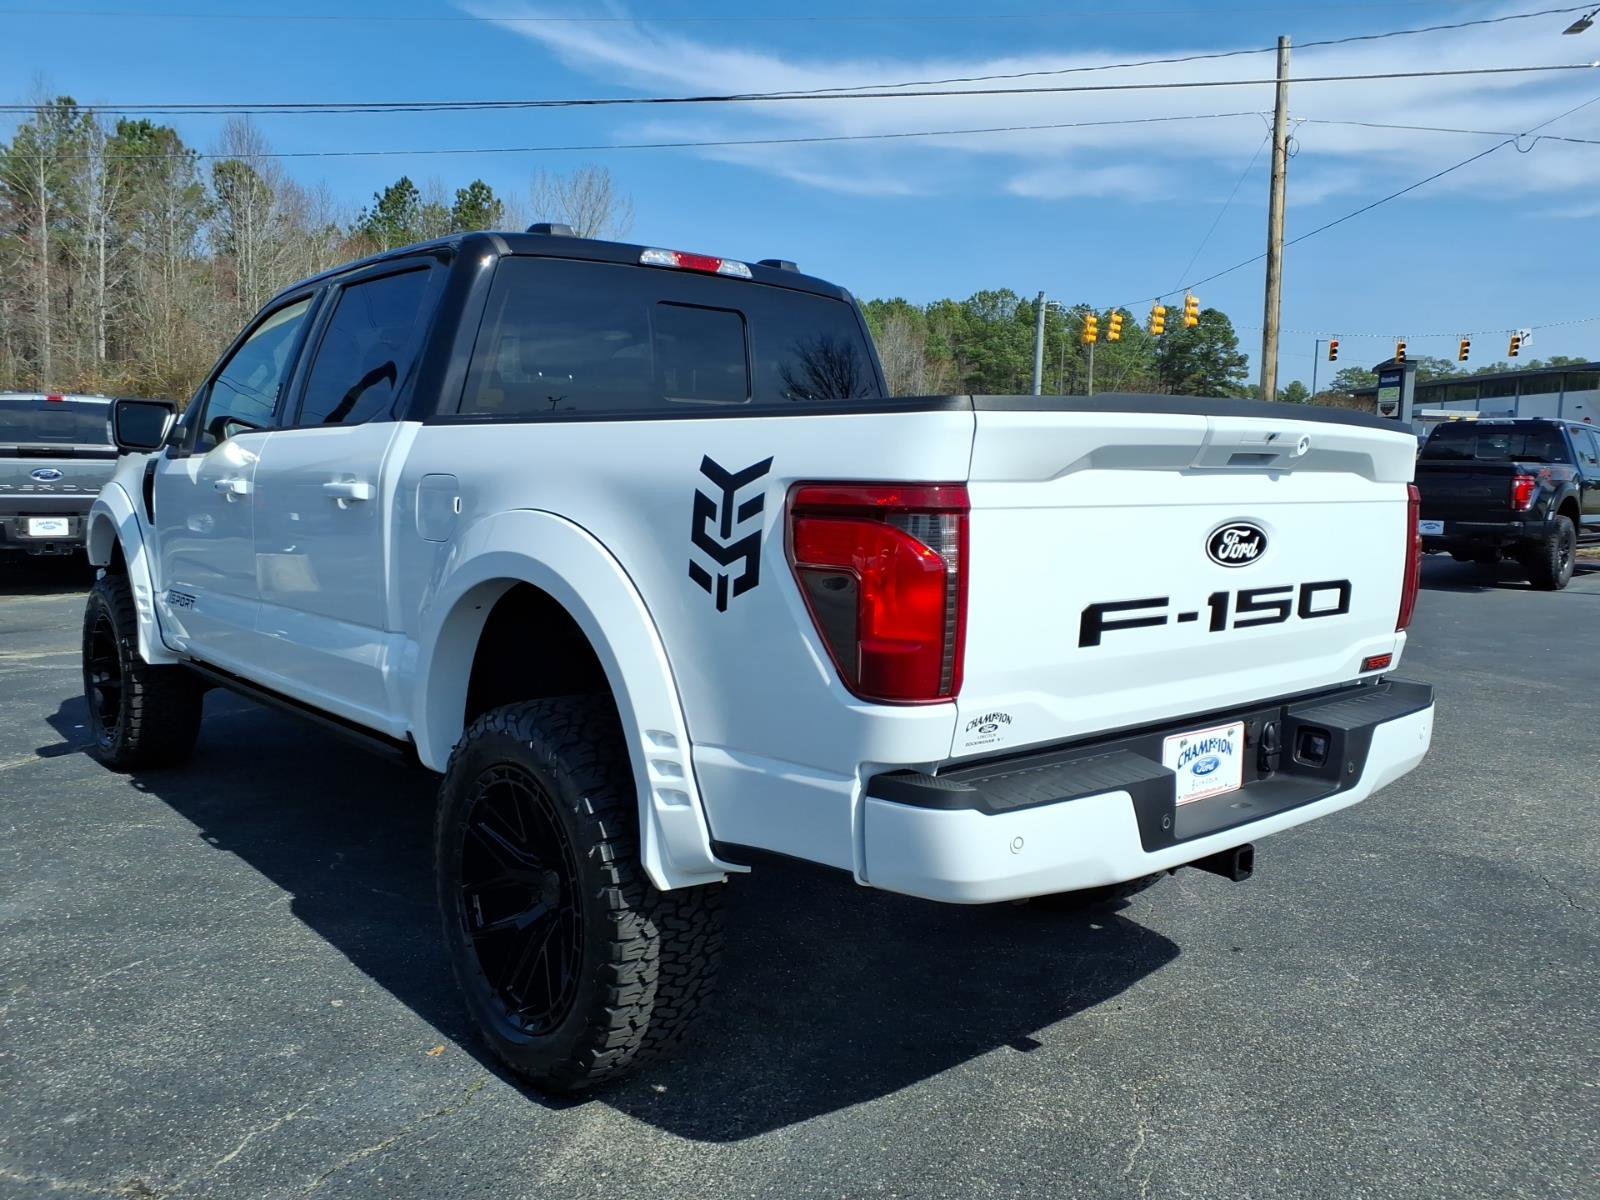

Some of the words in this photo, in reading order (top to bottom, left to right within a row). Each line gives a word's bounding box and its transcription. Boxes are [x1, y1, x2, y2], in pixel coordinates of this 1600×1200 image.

[1218, 529, 1260, 559] Ford
[1078, 579, 1353, 648] F-150
[965, 712, 1013, 733] CHAMPION
[1177, 737, 1233, 770] CHAMPION
